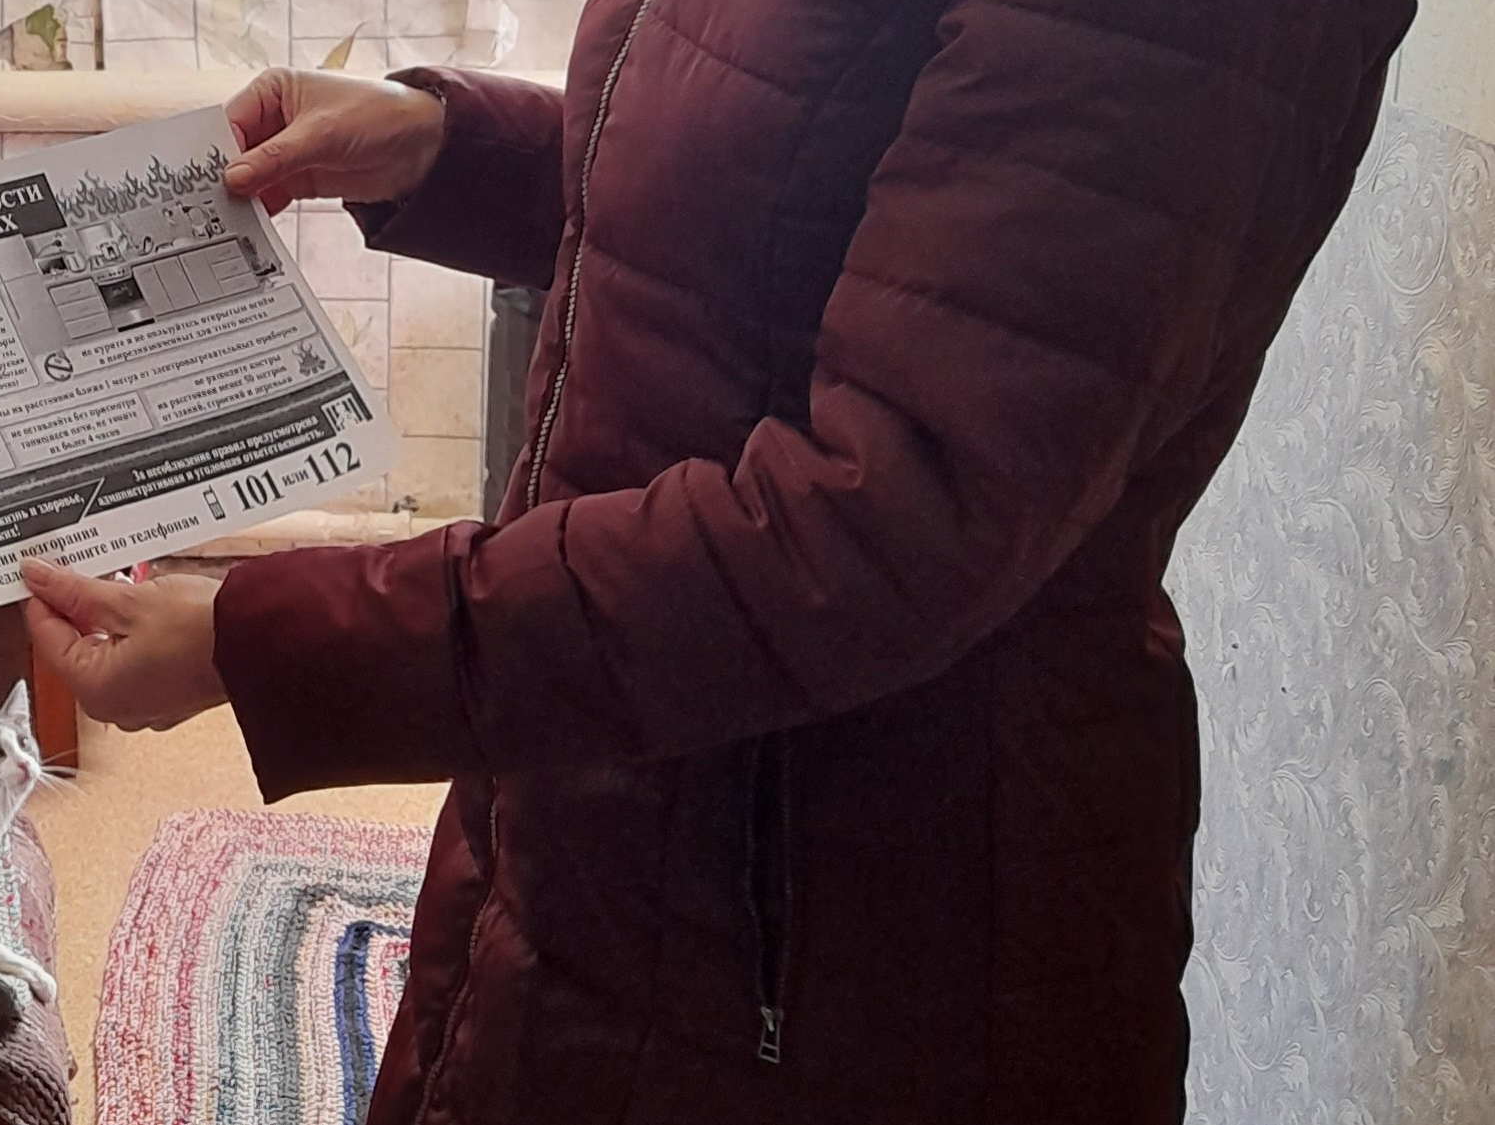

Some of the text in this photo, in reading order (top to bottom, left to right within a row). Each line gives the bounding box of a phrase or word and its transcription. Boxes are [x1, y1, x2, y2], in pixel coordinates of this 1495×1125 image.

[232, 442, 360, 509] 101 или 112
[20, 527, 98, 557] возгорания
[109, 537, 126, 550] по
[129, 516, 199, 544] телефонам
